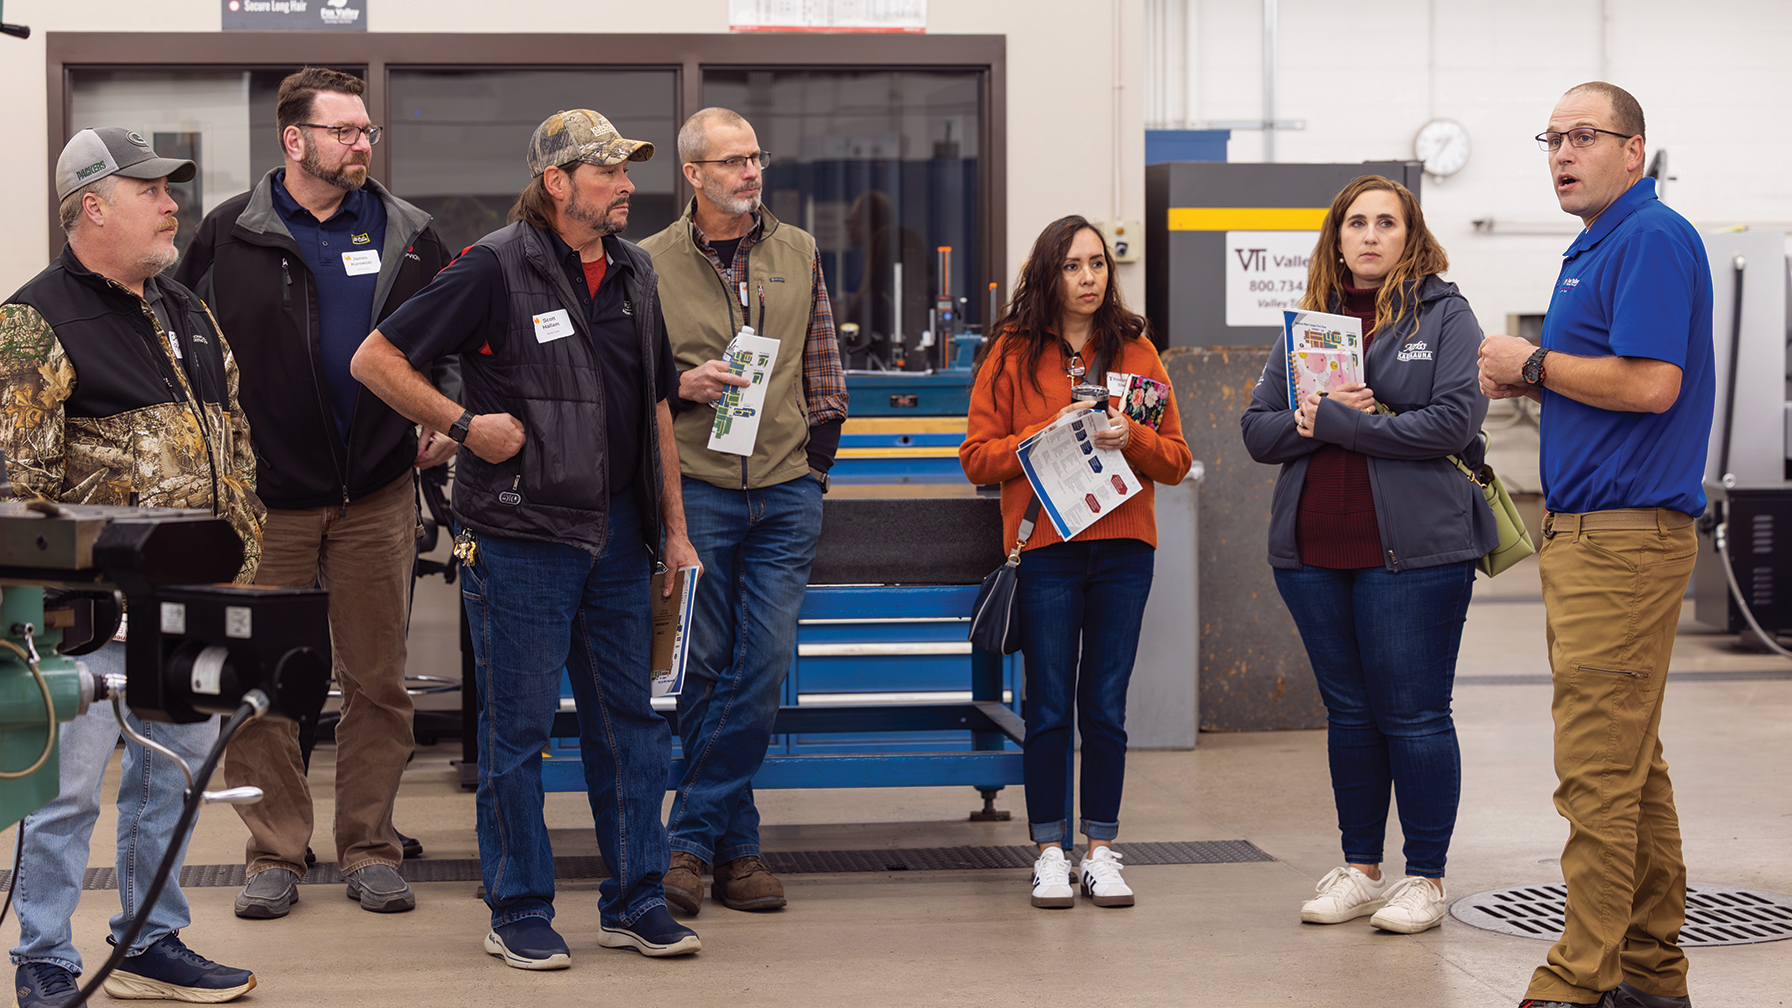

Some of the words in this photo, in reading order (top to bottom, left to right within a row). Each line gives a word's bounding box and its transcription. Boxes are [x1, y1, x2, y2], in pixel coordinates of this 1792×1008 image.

[244, 0, 271, 12] Secure
[271, 0, 290, 14] Long
[290, 0, 307, 12] Hair
[76, 160, 107, 181] PACKERS
[1273, 255, 1309, 268] Valle
[1257, 299, 1288, 309] Valley
